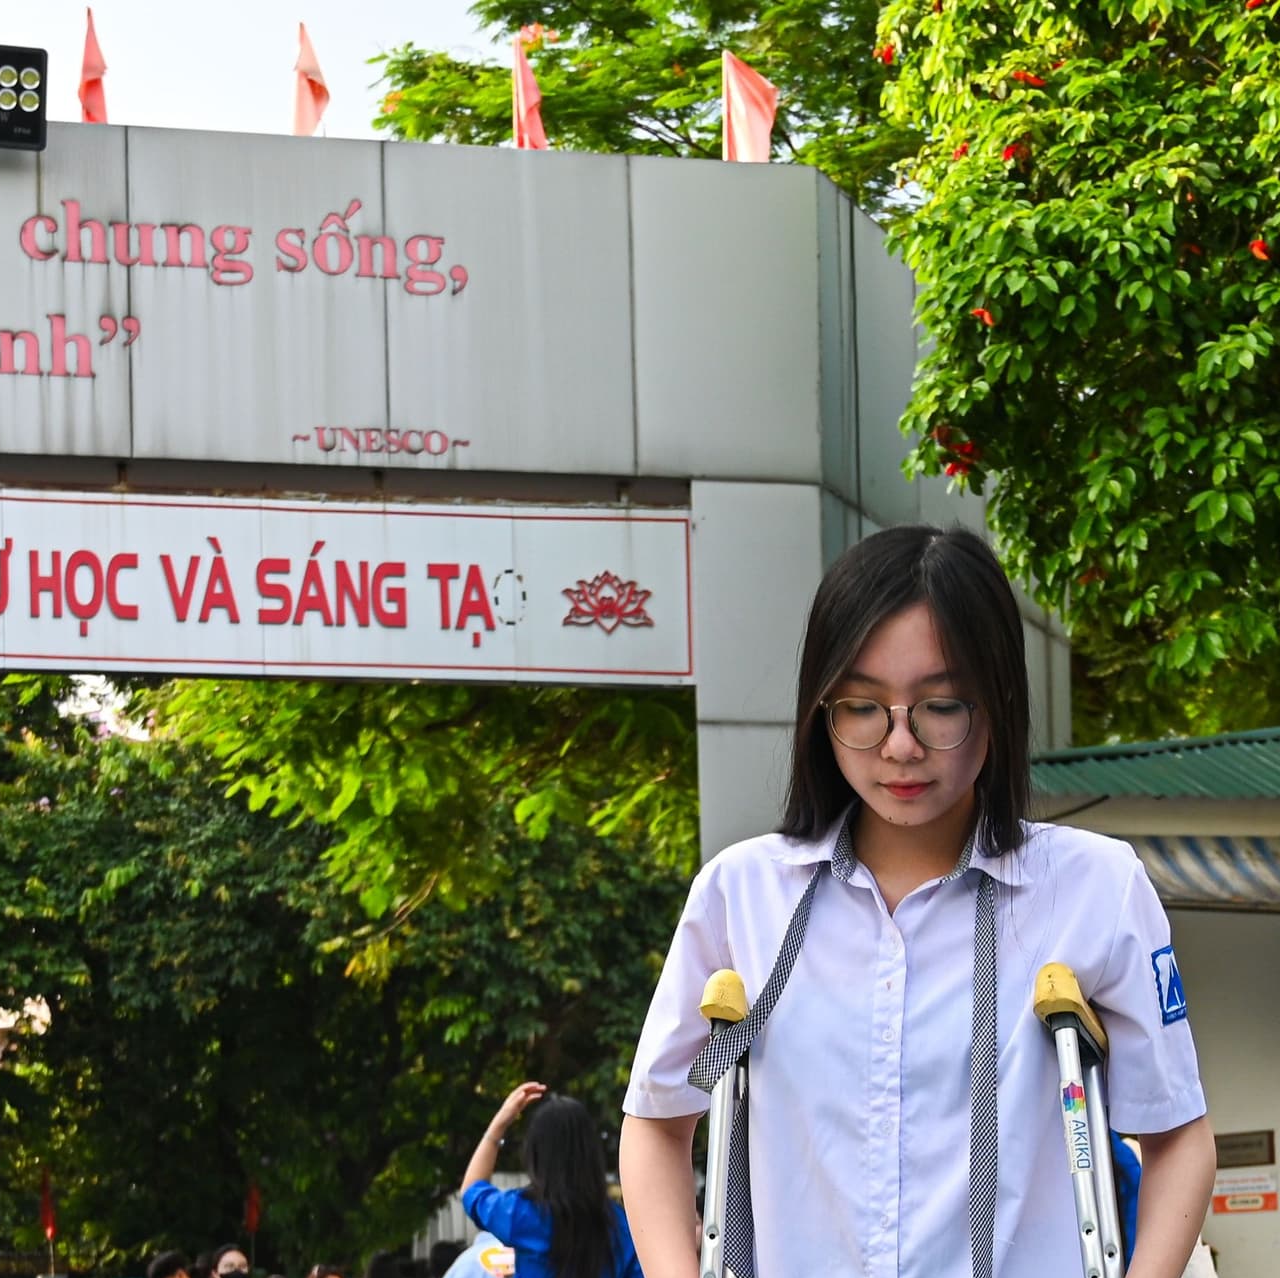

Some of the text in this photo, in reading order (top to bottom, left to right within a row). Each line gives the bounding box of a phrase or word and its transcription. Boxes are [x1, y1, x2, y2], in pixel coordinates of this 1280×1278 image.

[19, 199, 255, 286] chung
[275, 199, 469, 297] sống,
[28, 548, 140, 638] HỌC
[159, 535, 241, 625] VÀ
[256, 538, 409, 630] SÁNG
[1072, 1119, 1091, 1169] AKIKO
